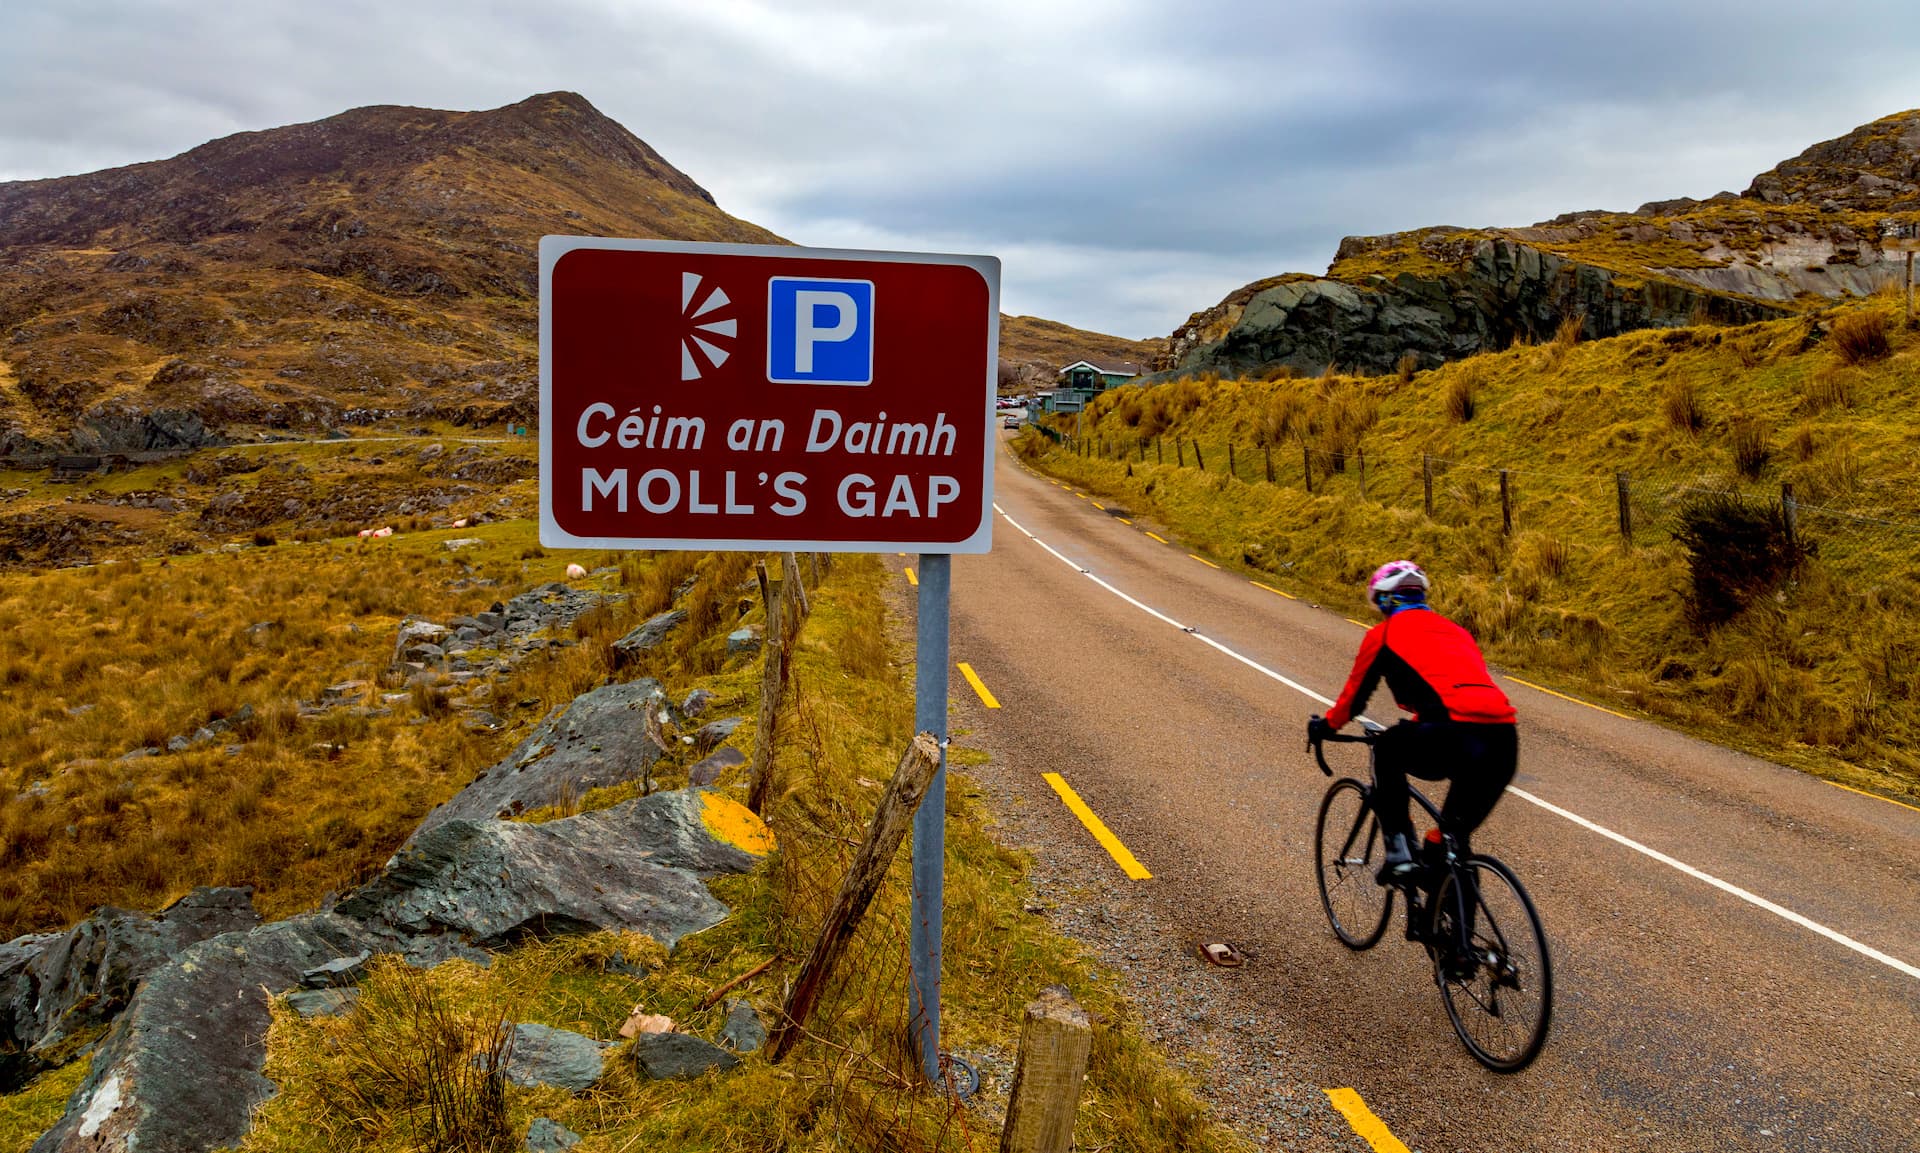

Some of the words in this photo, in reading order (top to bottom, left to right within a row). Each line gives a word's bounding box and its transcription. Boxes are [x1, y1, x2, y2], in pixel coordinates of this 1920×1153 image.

[794, 289, 858, 373] P
[577, 402, 706, 450] Céim
[727, 419, 785, 452] an
[805, 409, 957, 456] Daimh
[582, 468, 807, 516] MOLL'S
[837, 473, 961, 518] GAP
